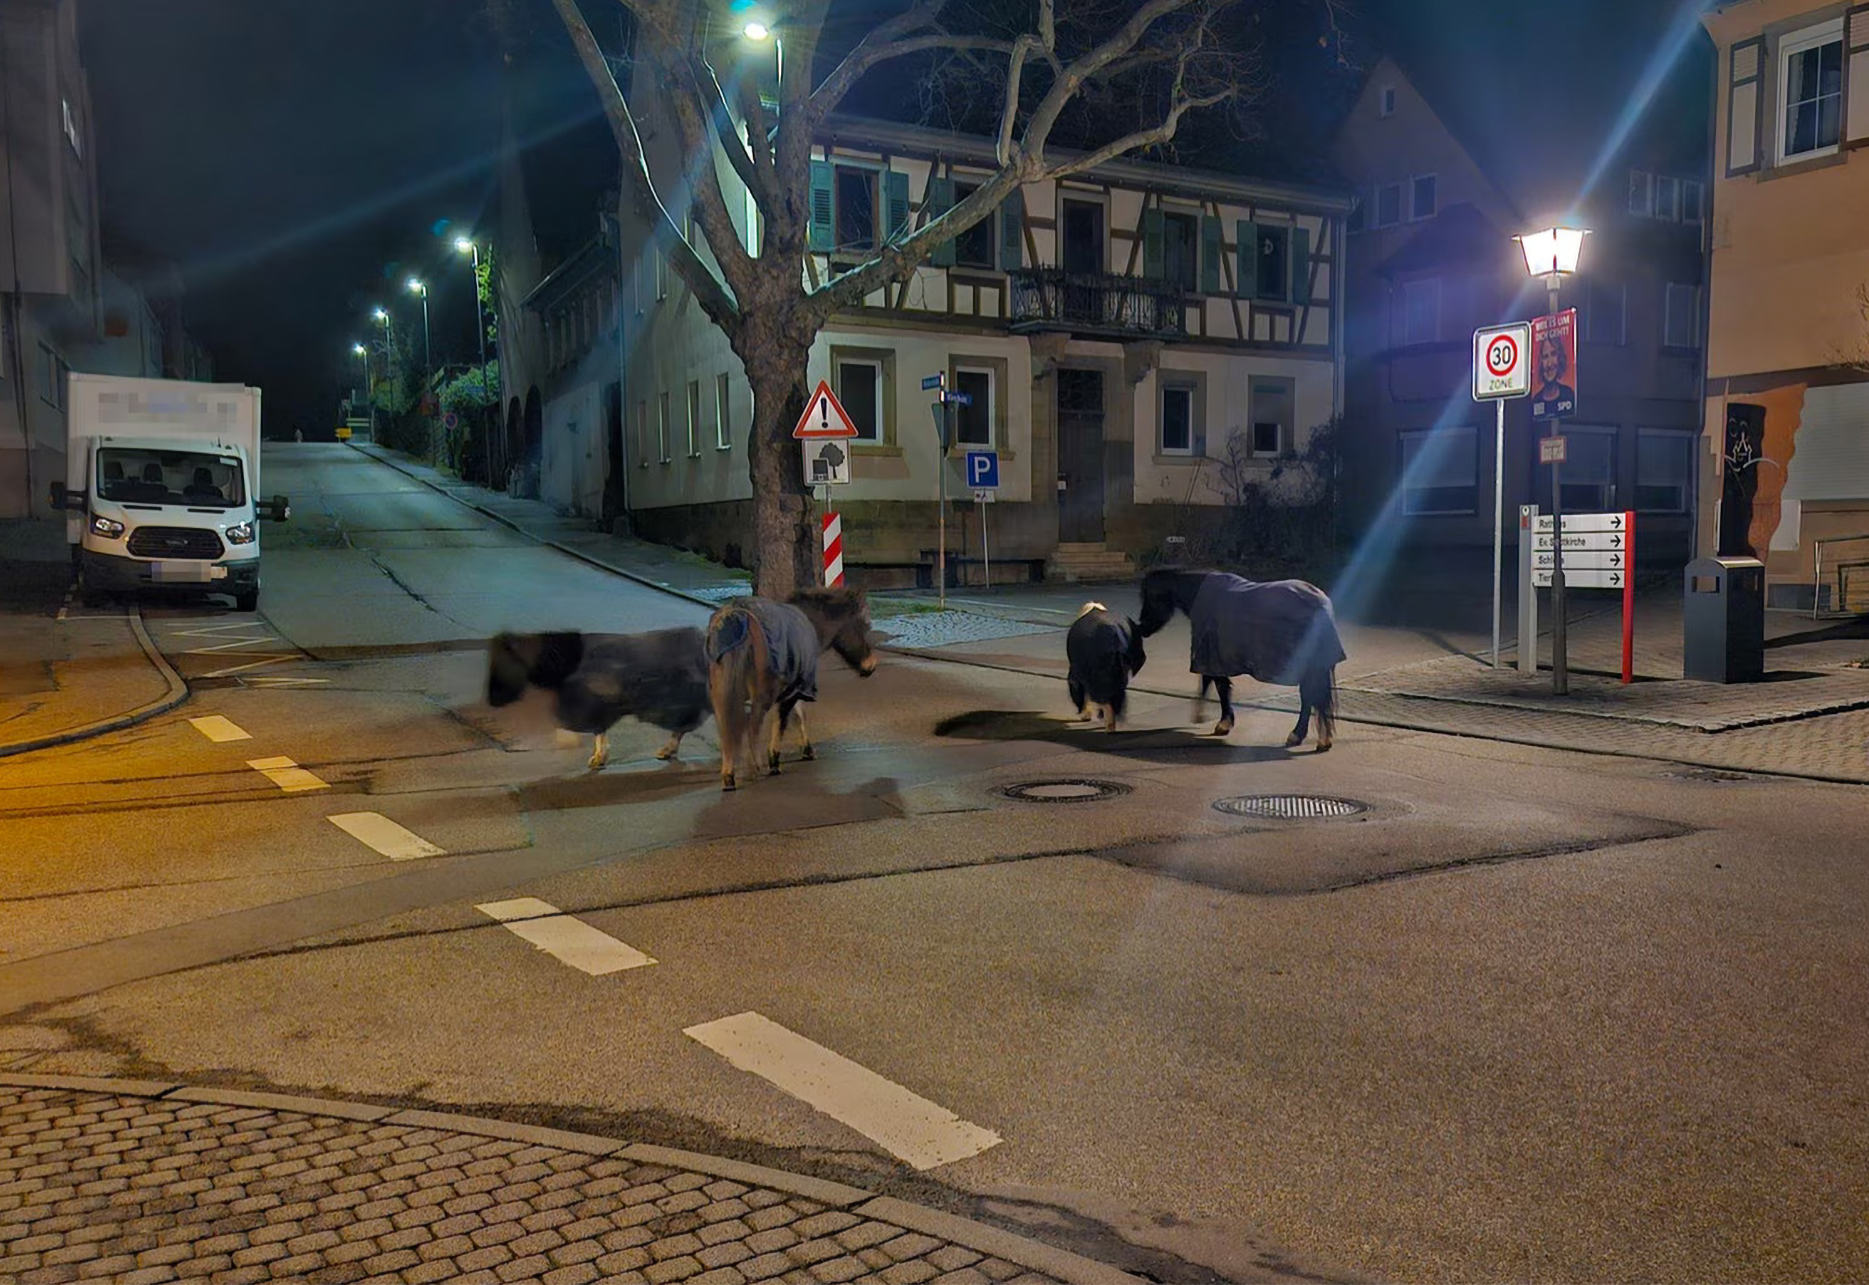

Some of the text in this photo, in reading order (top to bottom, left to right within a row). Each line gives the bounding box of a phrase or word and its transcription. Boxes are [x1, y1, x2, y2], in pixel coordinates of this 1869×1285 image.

[1492, 345, 1512, 366] 30
[1489, 377, 1513, 391] ZONE
[1557, 400, 1572, 411] SPD
[974, 456, 991, 483] P
